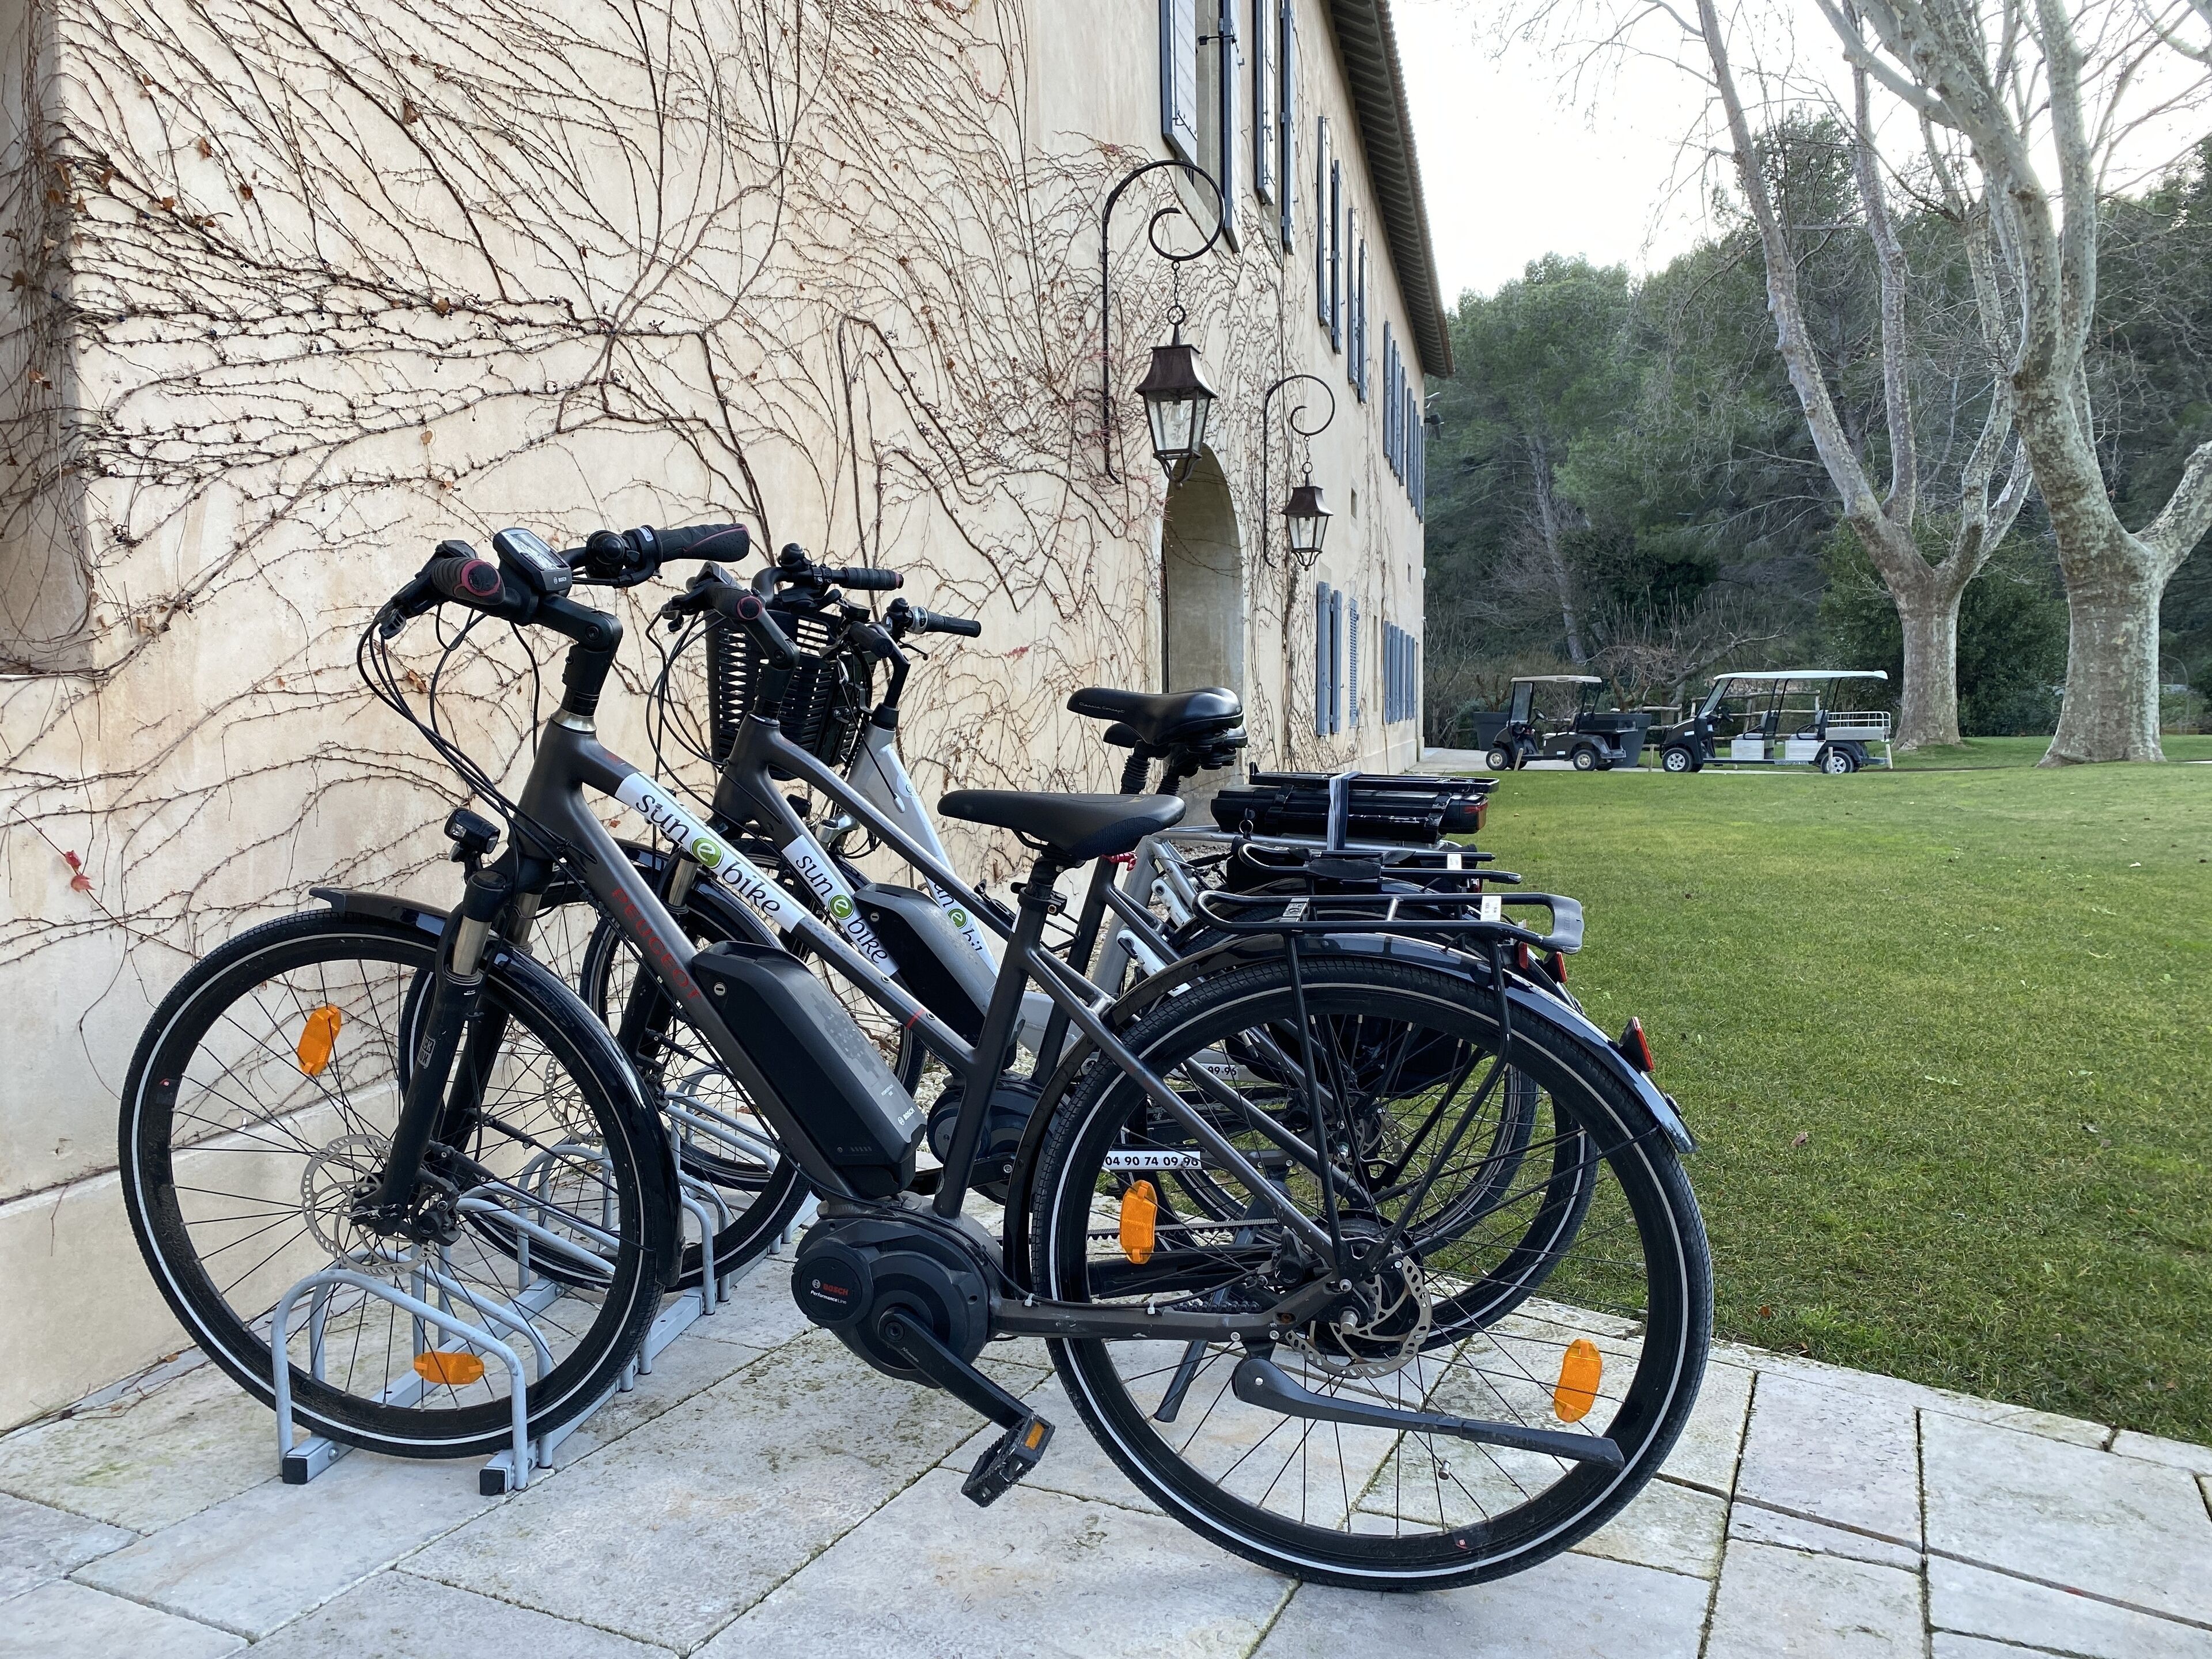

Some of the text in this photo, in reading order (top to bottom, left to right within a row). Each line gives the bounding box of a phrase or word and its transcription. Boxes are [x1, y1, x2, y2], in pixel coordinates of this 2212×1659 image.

[636, 794, 690, 844] sun
[722, 860, 781, 918] bike
[796, 855, 833, 897] sun
[847, 916, 888, 964] bike
[612, 888, 702, 999] PEUGEOT
[903, 1107, 915, 1120] BOSCH
[1105, 1156, 1120, 1166] 04
[1124, 1156, 1140, 1166] 90
[1145, 1156, 1159, 1166] 74
[1163, 1156, 1179, 1166] 09
[823, 1283, 849, 1296] BOSCH
